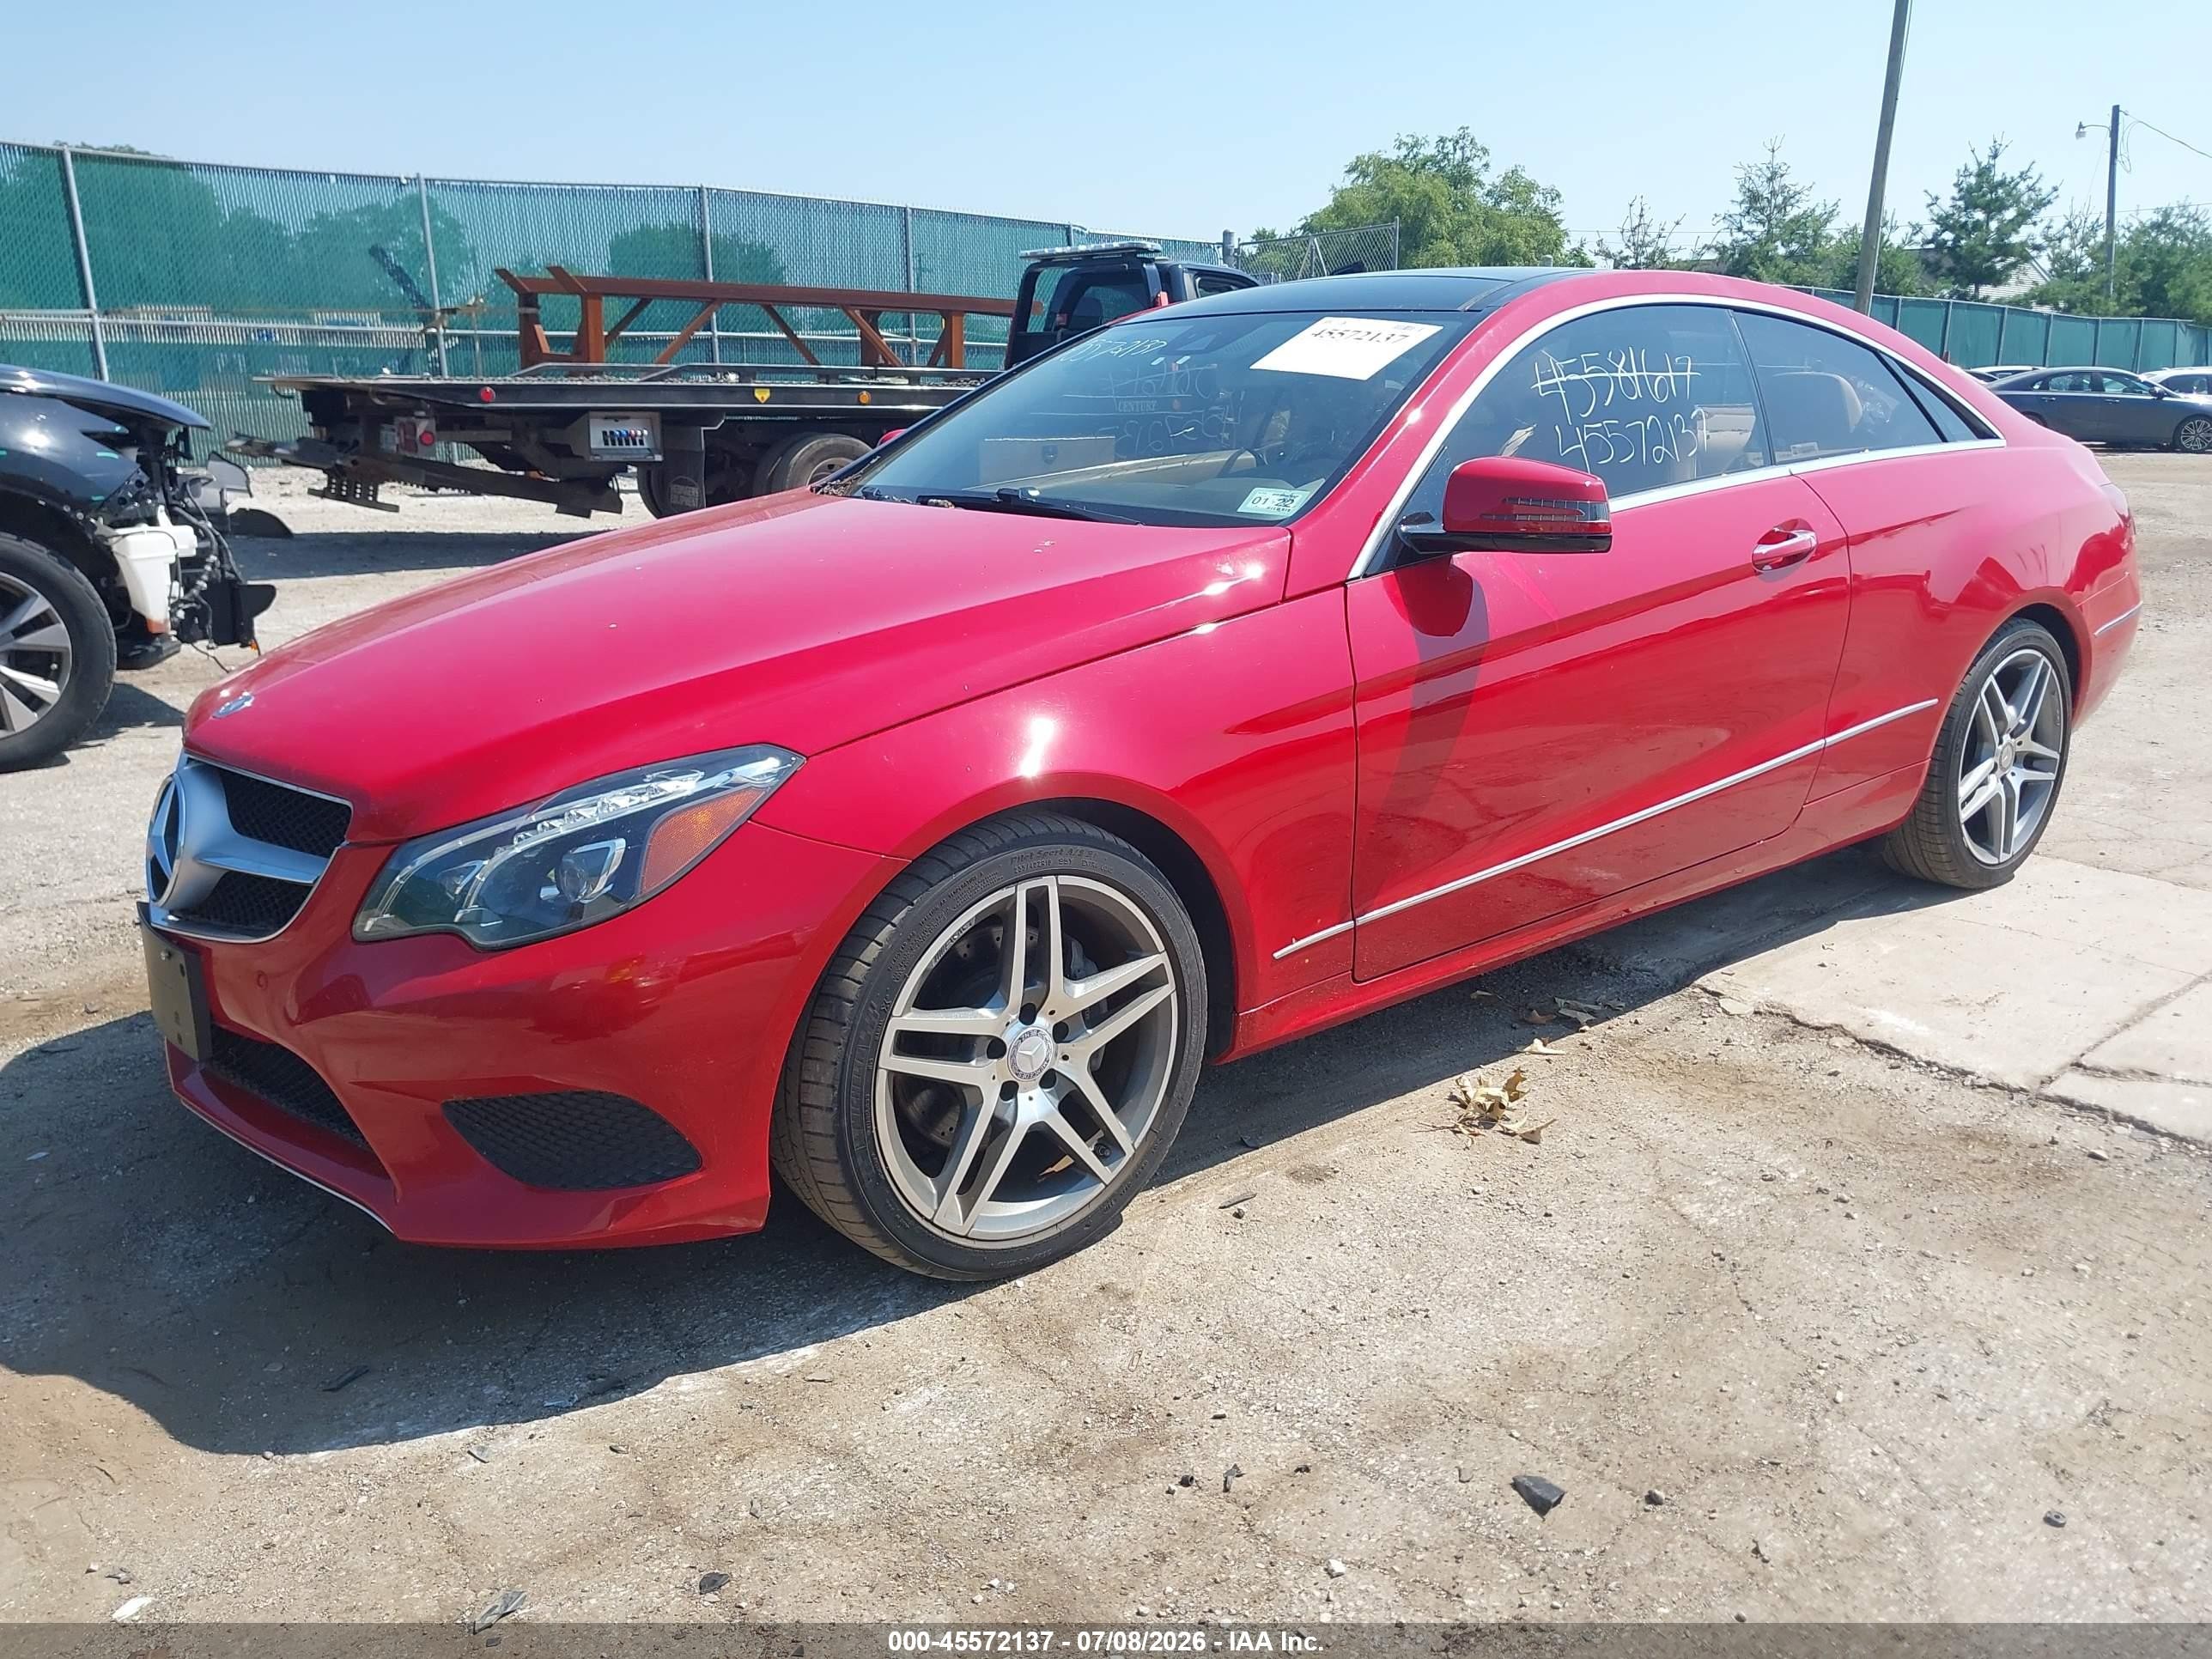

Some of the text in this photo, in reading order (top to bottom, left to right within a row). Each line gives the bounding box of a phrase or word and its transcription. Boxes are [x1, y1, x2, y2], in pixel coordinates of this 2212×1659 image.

[1310, 328, 1410, 344] 45572137
[1056, 338, 1168, 362] 5572137
[1555, 408, 1707, 475] 45572137
[1251, 496, 1269, 505] 01
